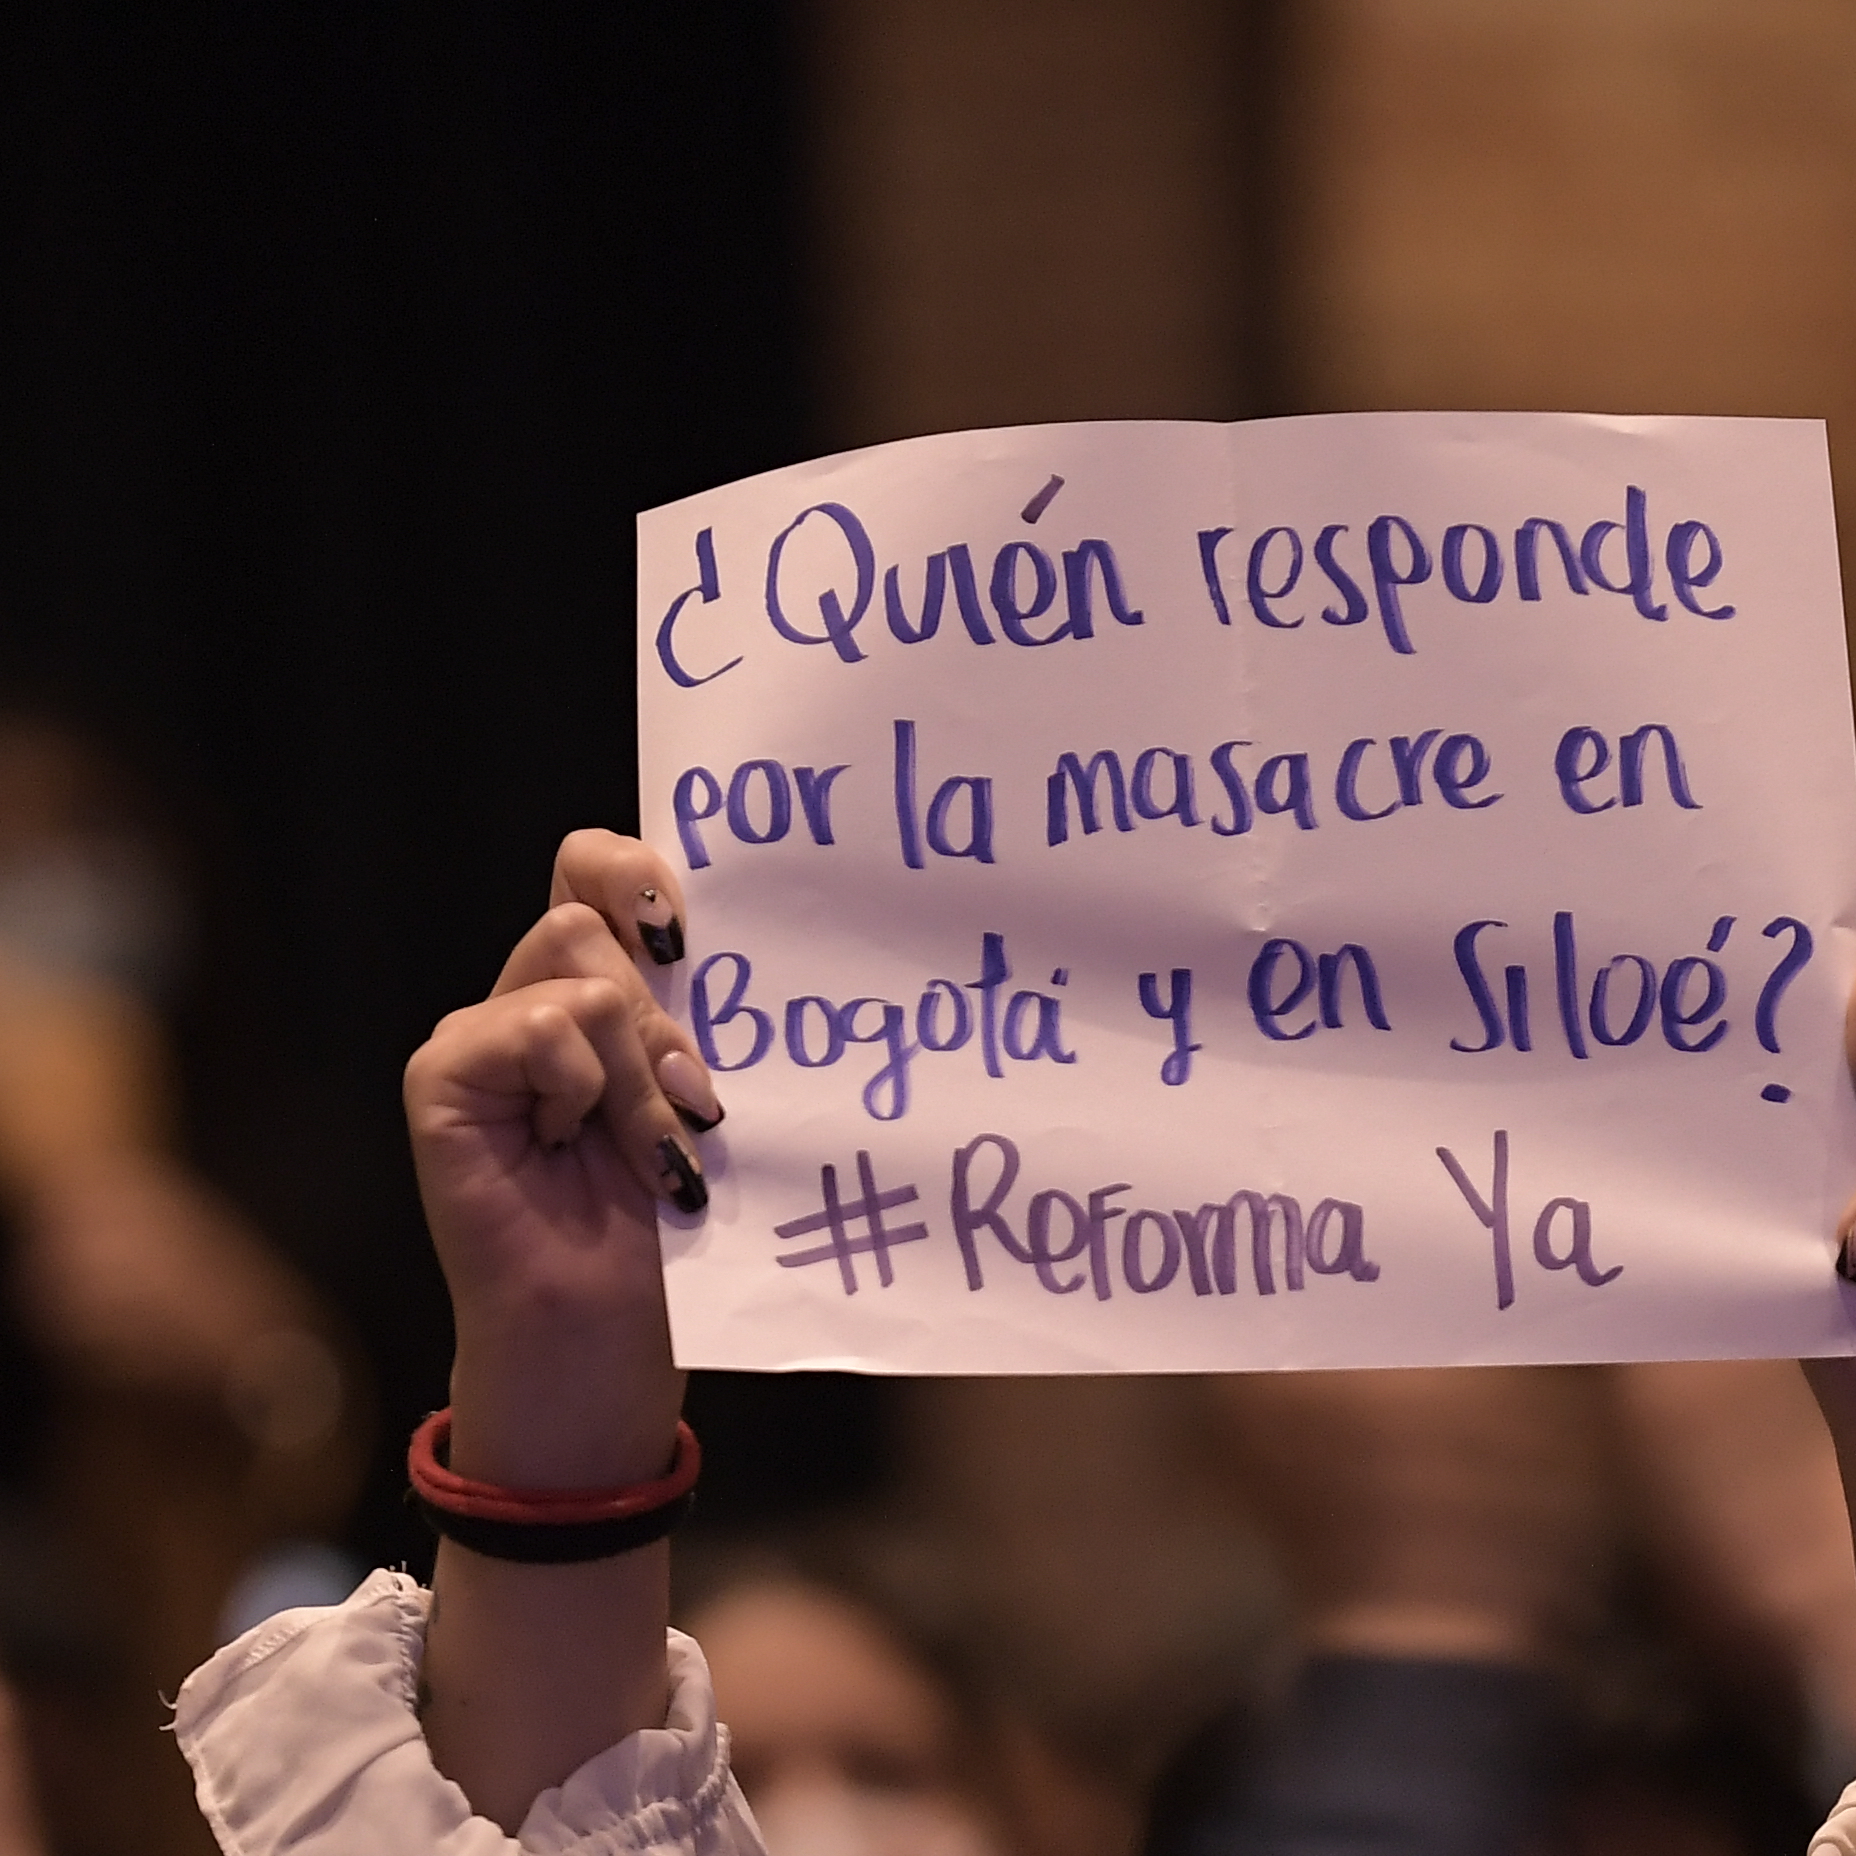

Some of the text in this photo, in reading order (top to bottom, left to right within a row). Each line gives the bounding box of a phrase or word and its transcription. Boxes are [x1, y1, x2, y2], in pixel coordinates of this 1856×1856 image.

[655, 474, 1736, 689] ¿Quién responde
[674, 719, 1701, 868] por la masacre en
[689, 911, 1814, 1120] Bogotá y en Siloé?
[1437, 1129, 1623, 1309] Ya
